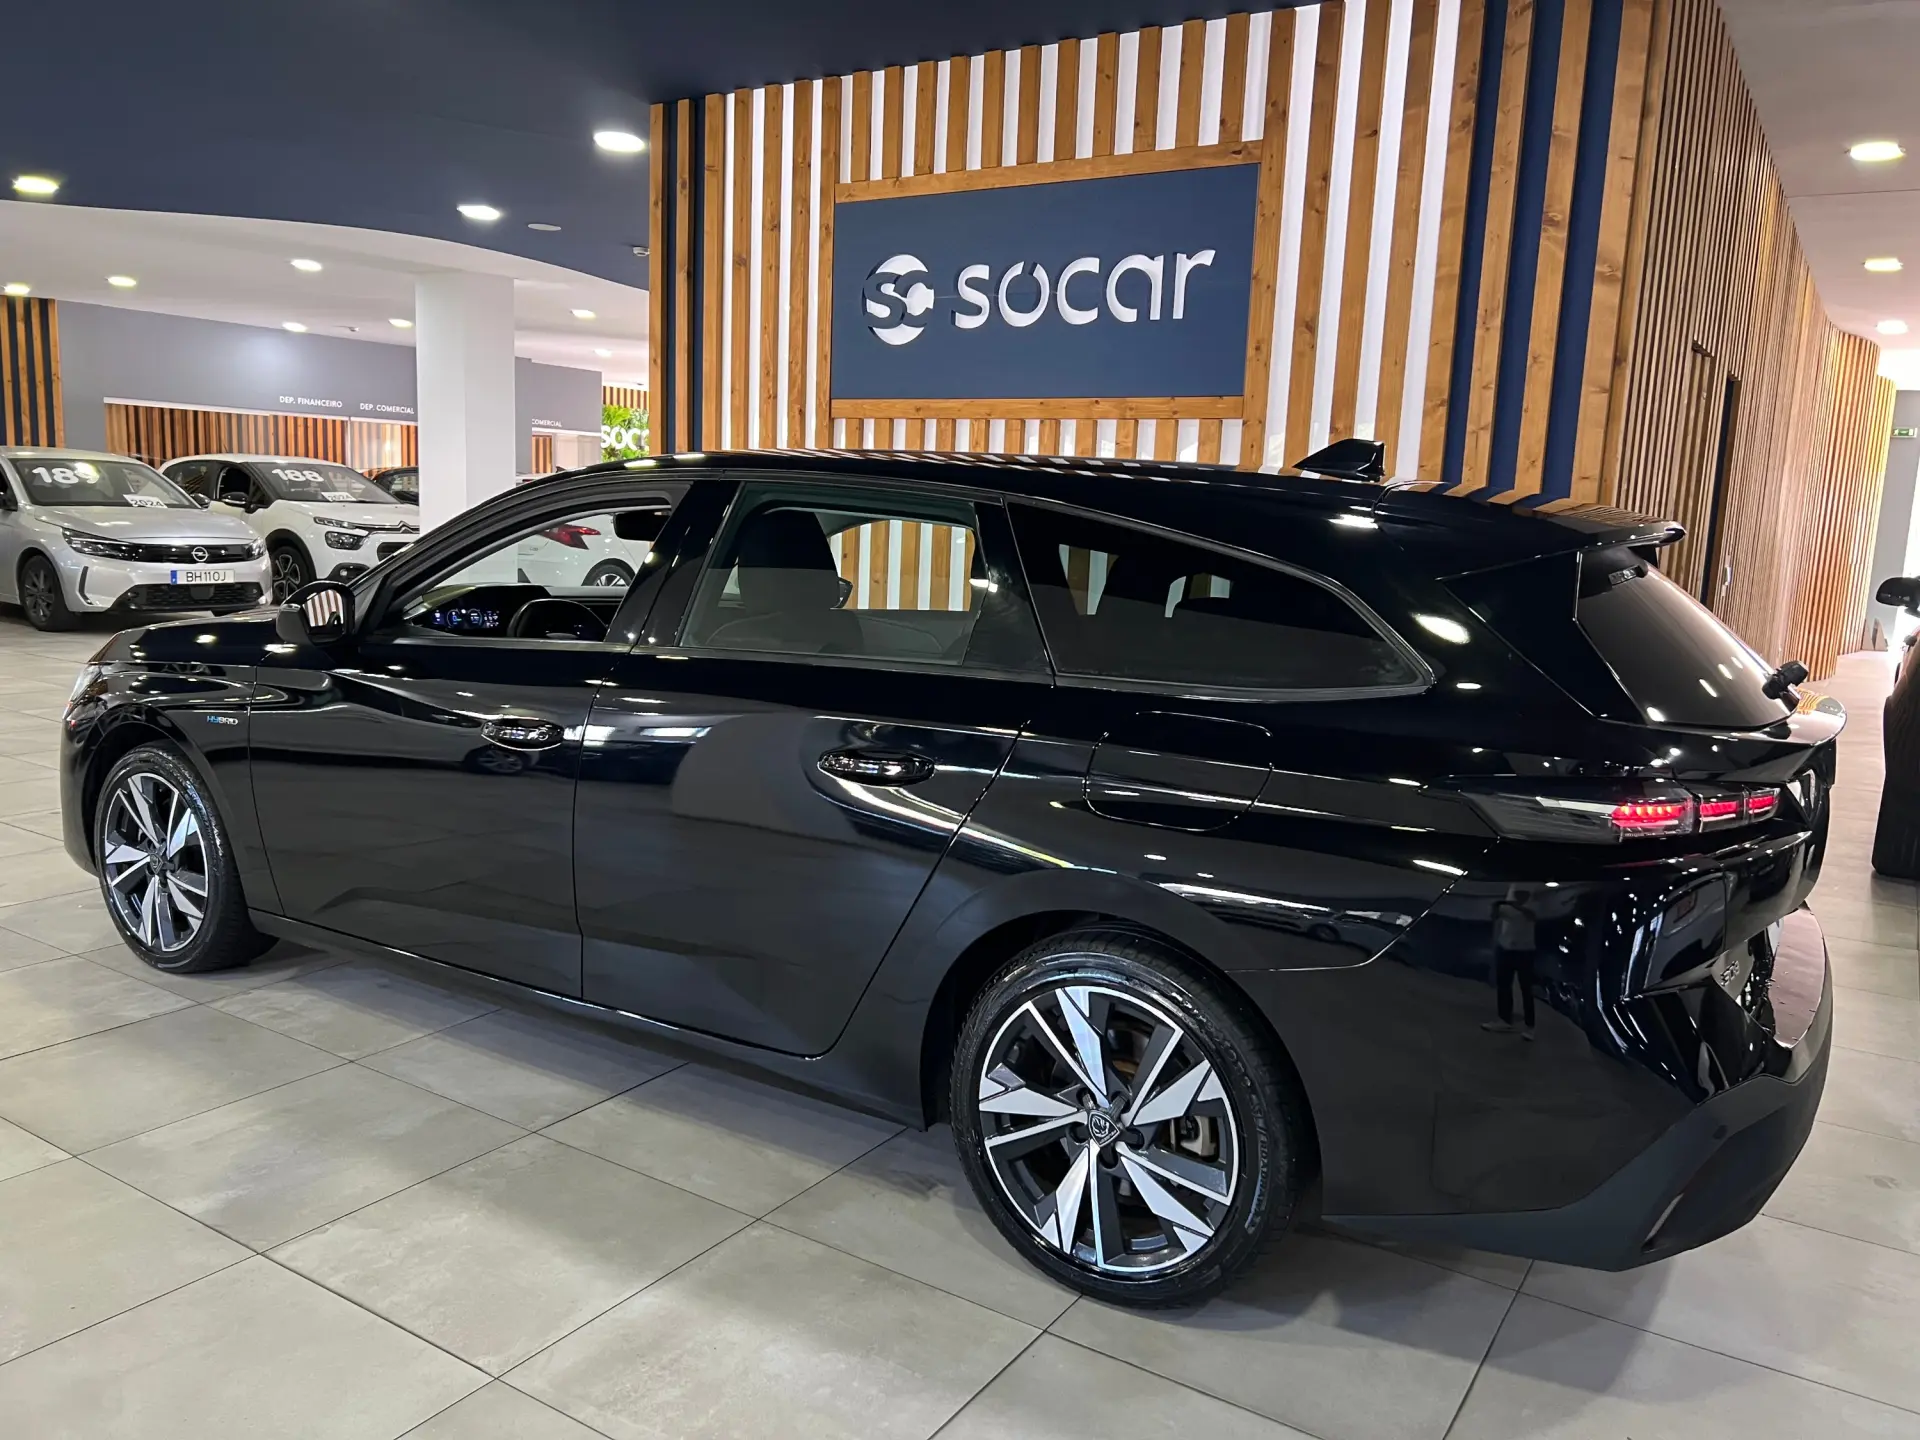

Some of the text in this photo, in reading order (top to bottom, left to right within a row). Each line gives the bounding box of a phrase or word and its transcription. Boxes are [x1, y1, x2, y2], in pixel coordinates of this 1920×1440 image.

[952, 249, 1216, 329] socar
[279, 395, 343, 408] DEP. FINANCEIRO
[360, 402, 415, 414] DEP. COMERCIAL
[271, 468, 324, 482] 188
